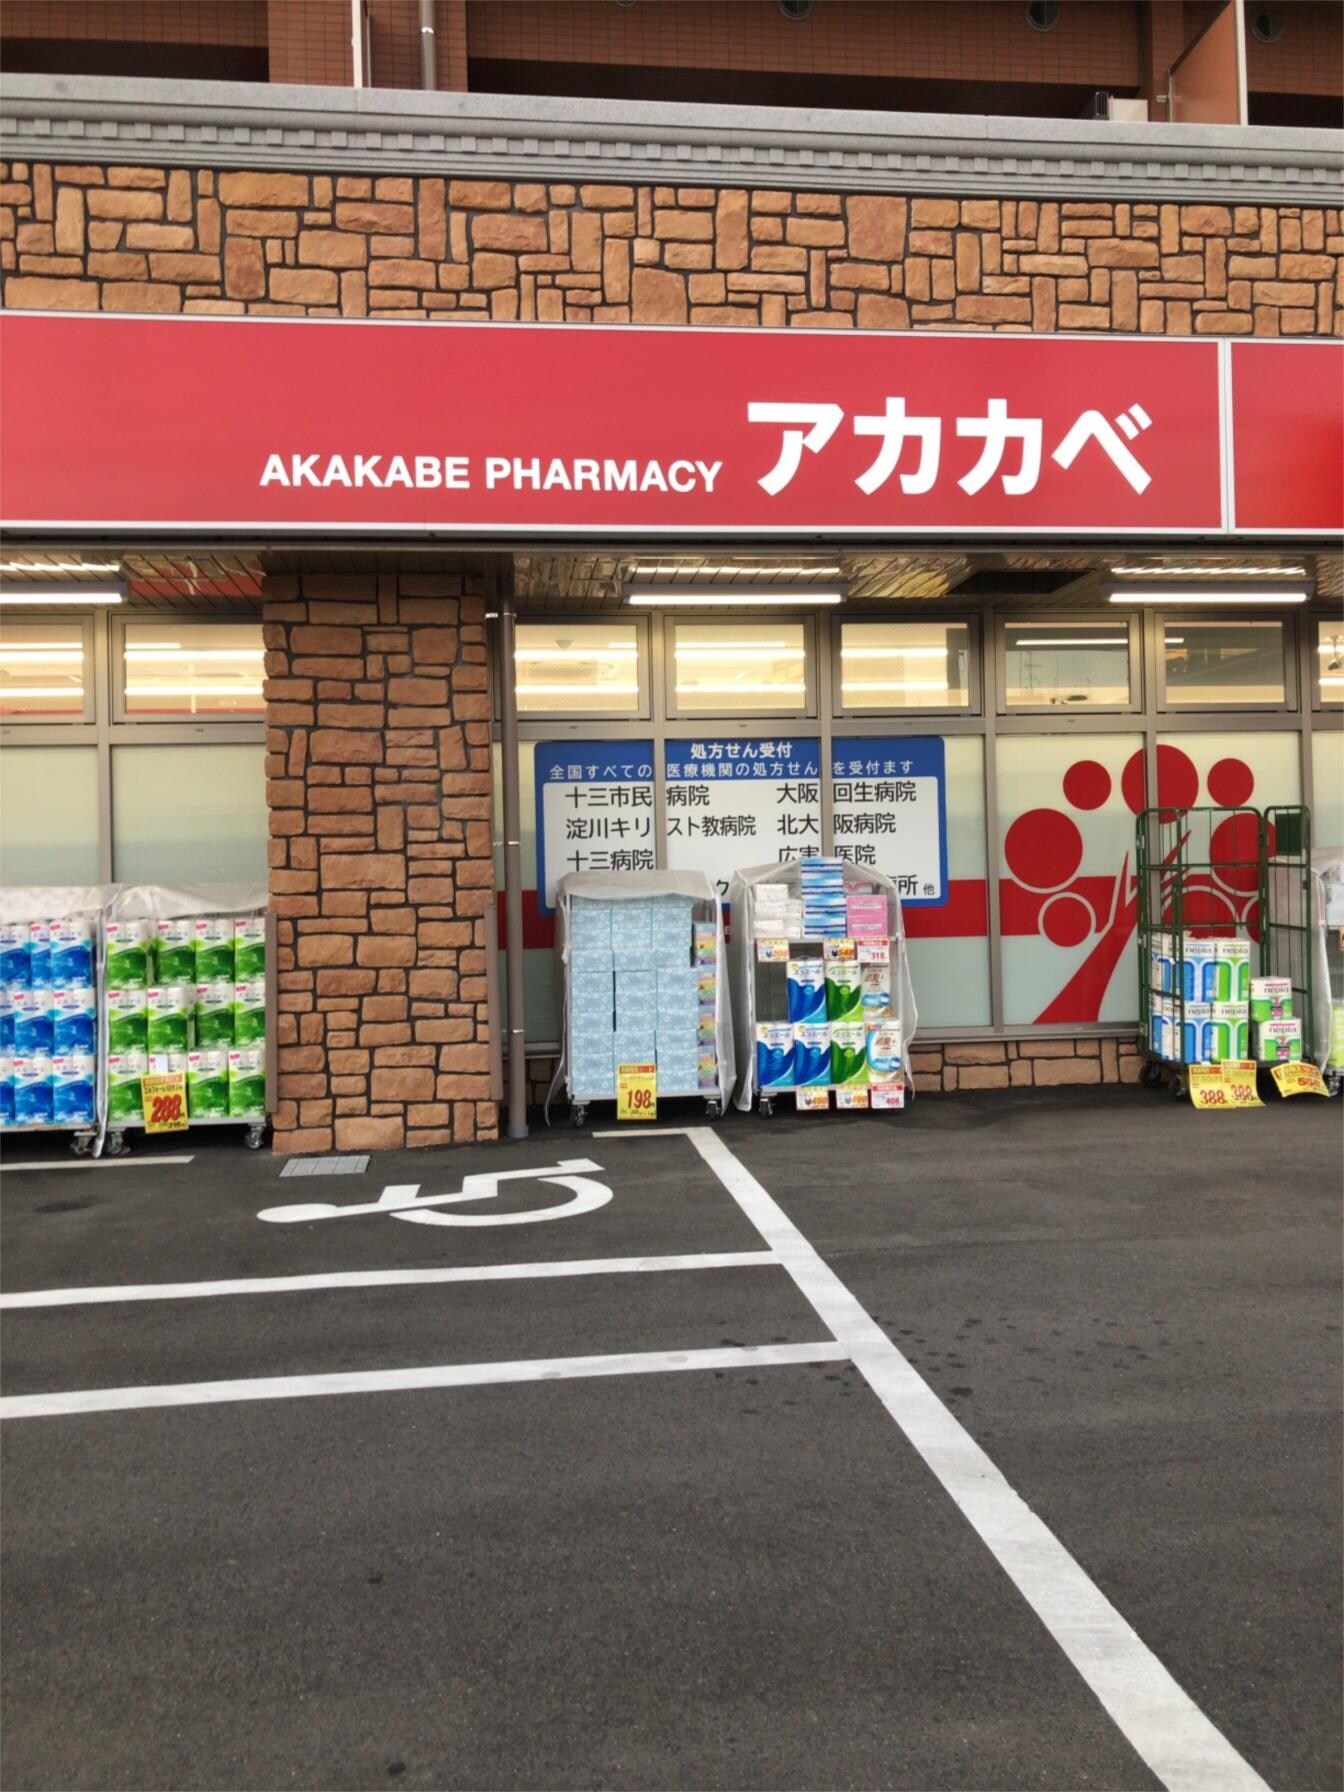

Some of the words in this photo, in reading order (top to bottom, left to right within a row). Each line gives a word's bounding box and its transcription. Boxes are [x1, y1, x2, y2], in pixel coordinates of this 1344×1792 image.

[747, 397, 1152, 496] アカカベ
[259, 454, 470, 488] AKAKABE
[485, 457, 724, 492] PHARMACY
[690, 742, 792, 759] 処方せん受付
[566, 849, 655, 872] 十三病院
[923, 883, 935, 895] 他
[151, 1094, 182, 1123] 288
[627, 1089, 652, 1109] 198
